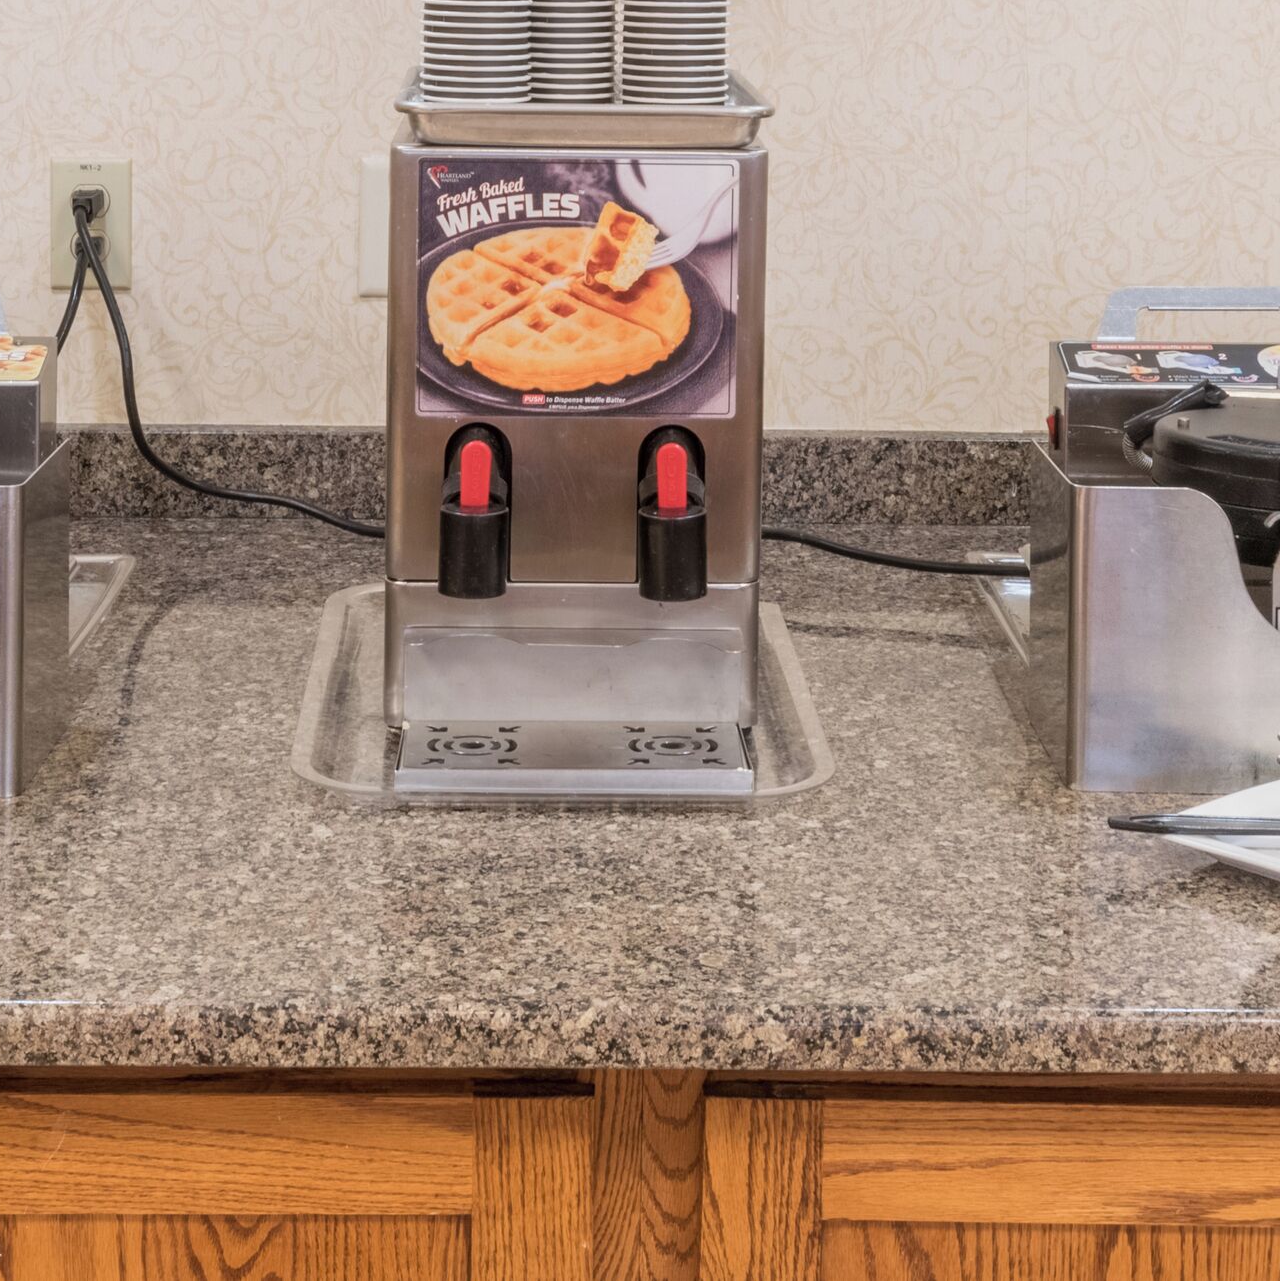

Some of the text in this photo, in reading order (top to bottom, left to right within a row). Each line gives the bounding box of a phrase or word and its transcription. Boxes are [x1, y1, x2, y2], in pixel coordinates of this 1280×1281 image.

[436, 177, 525, 212] Fresh Baked
[436, 193, 581, 238] WAFFLES
